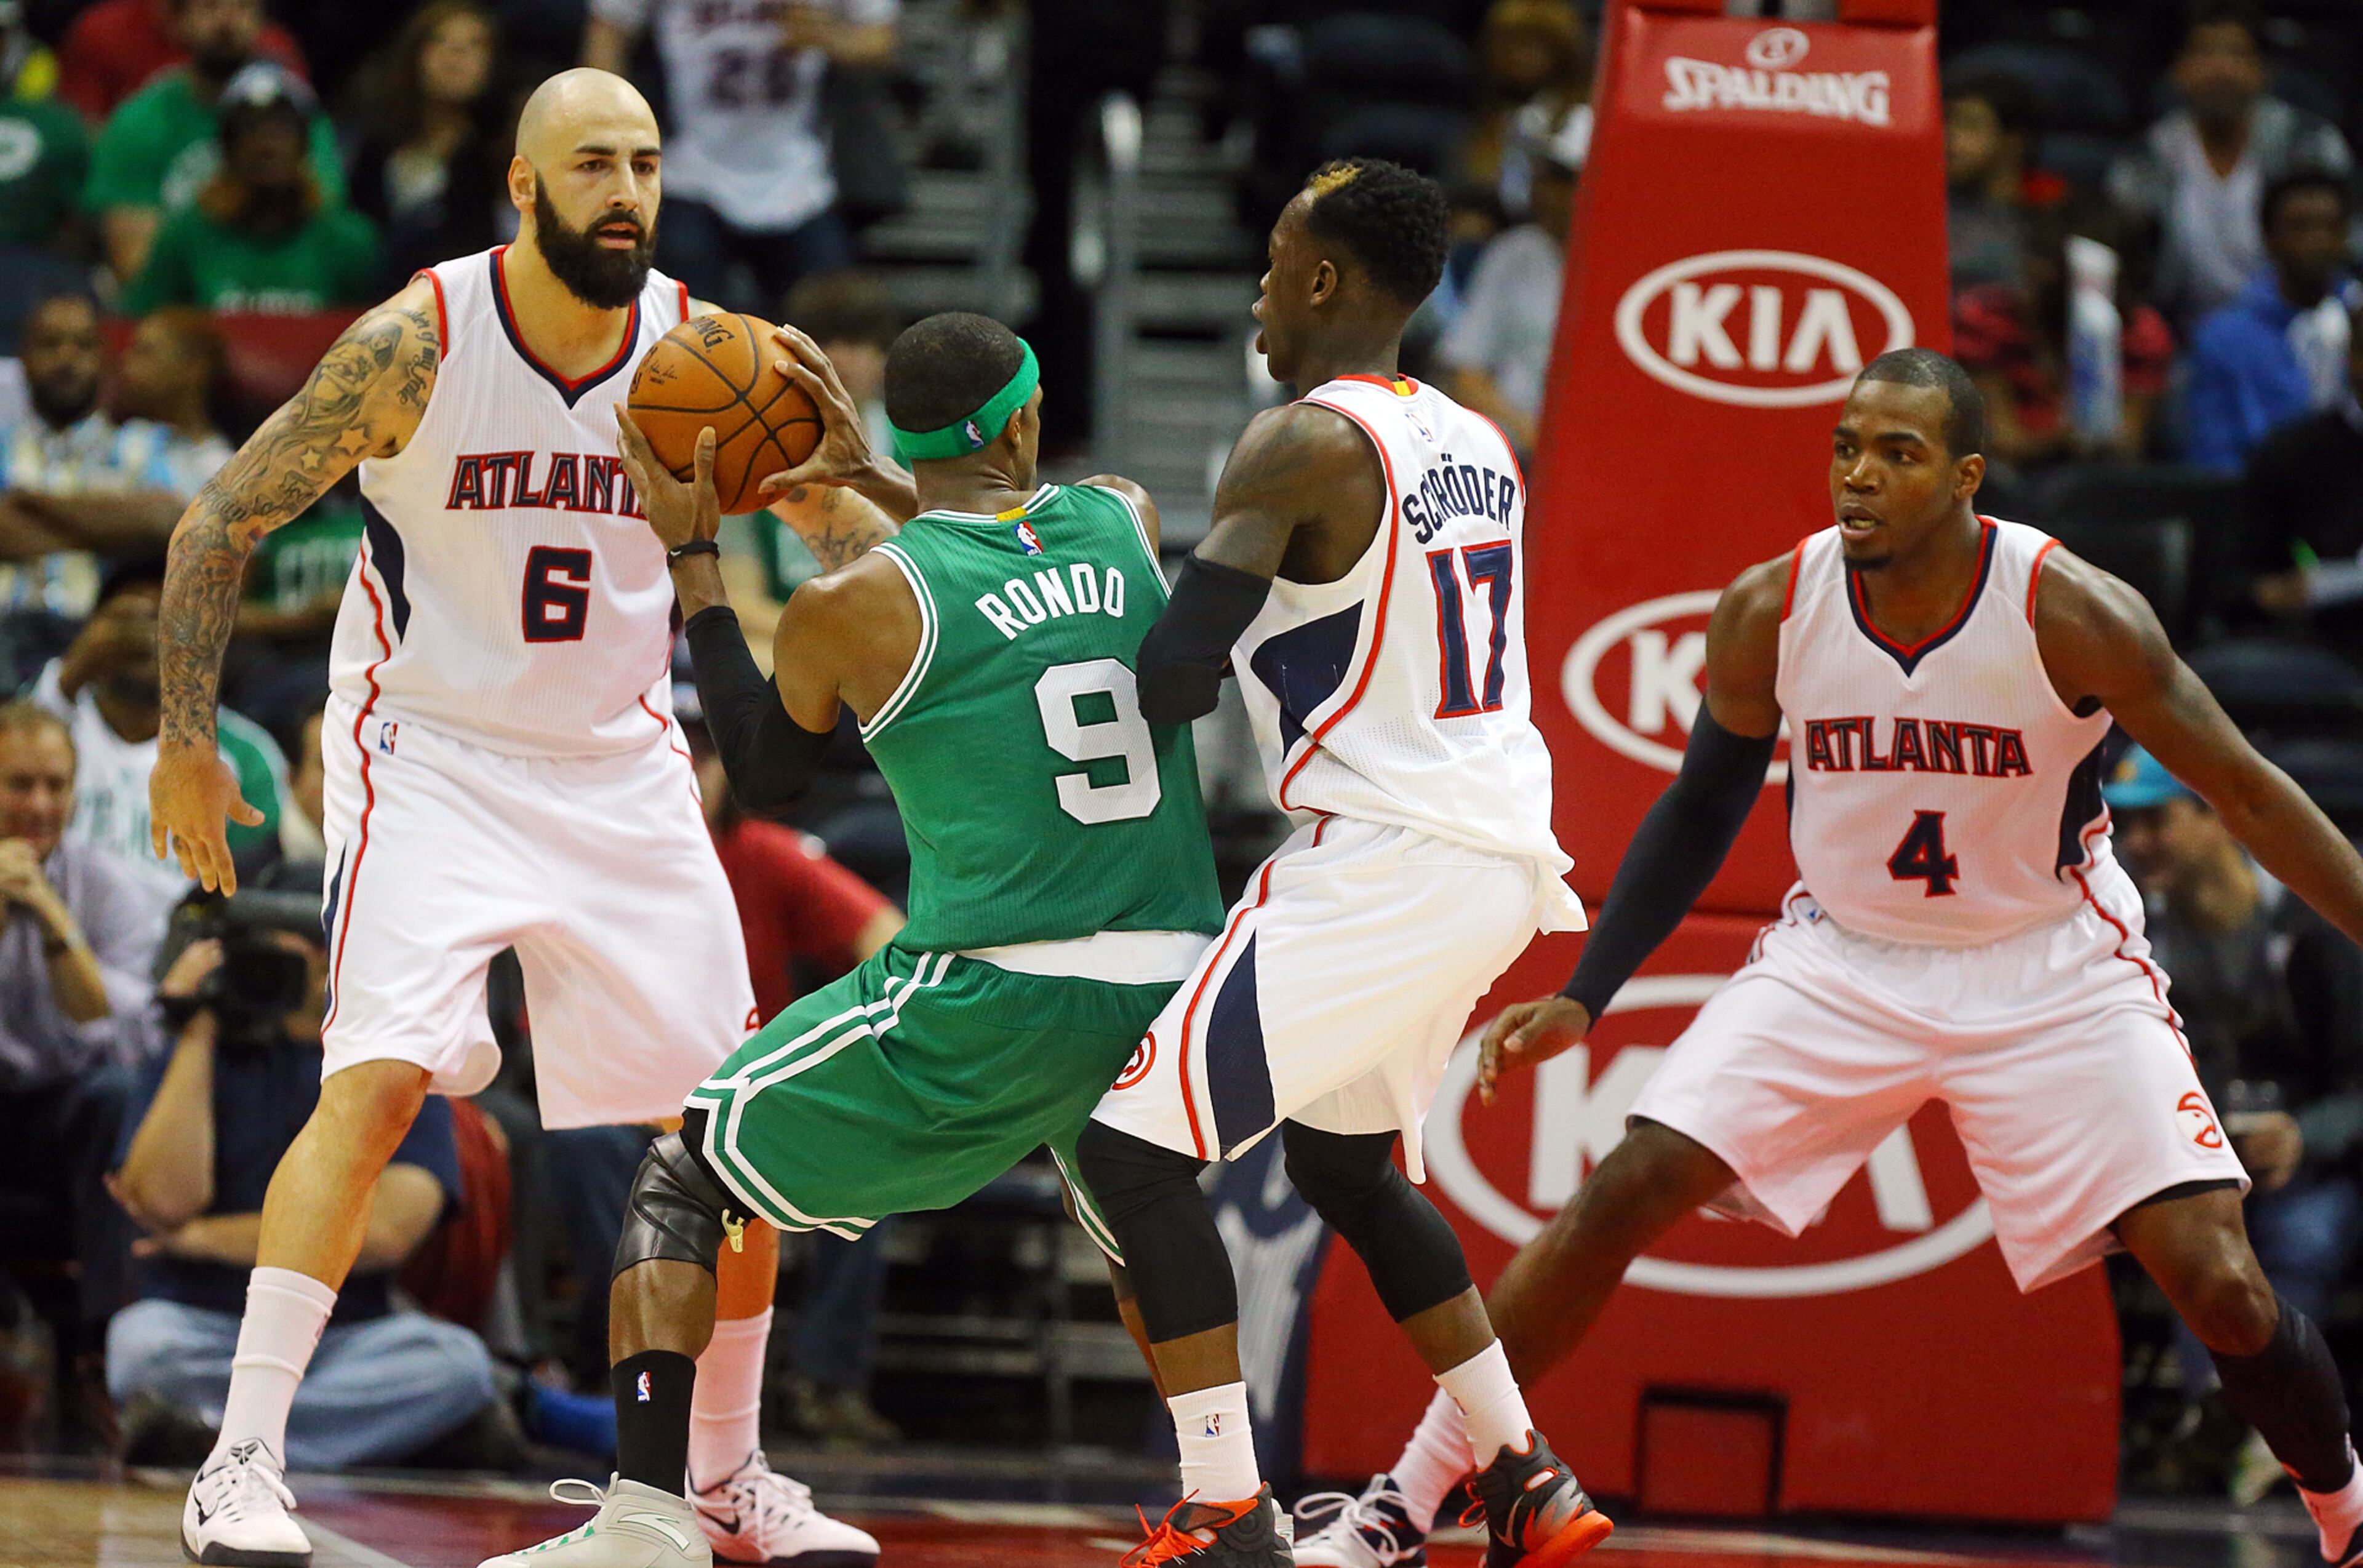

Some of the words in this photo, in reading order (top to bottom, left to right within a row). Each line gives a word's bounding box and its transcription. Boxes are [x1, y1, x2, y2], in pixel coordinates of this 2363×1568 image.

[1664, 58, 1889, 127] SPALDING
[1668, 282, 1865, 374] KIA
[445, 450, 649, 522] ATLANT
[522, 545, 592, 642] 6
[975, 562, 1126, 641] RONDO
[1425, 539, 1513, 719] 17
[1034, 658, 1162, 825] 9
[1804, 715, 2033, 778] ATLANTA
[1886, 810, 1959, 898] 4
